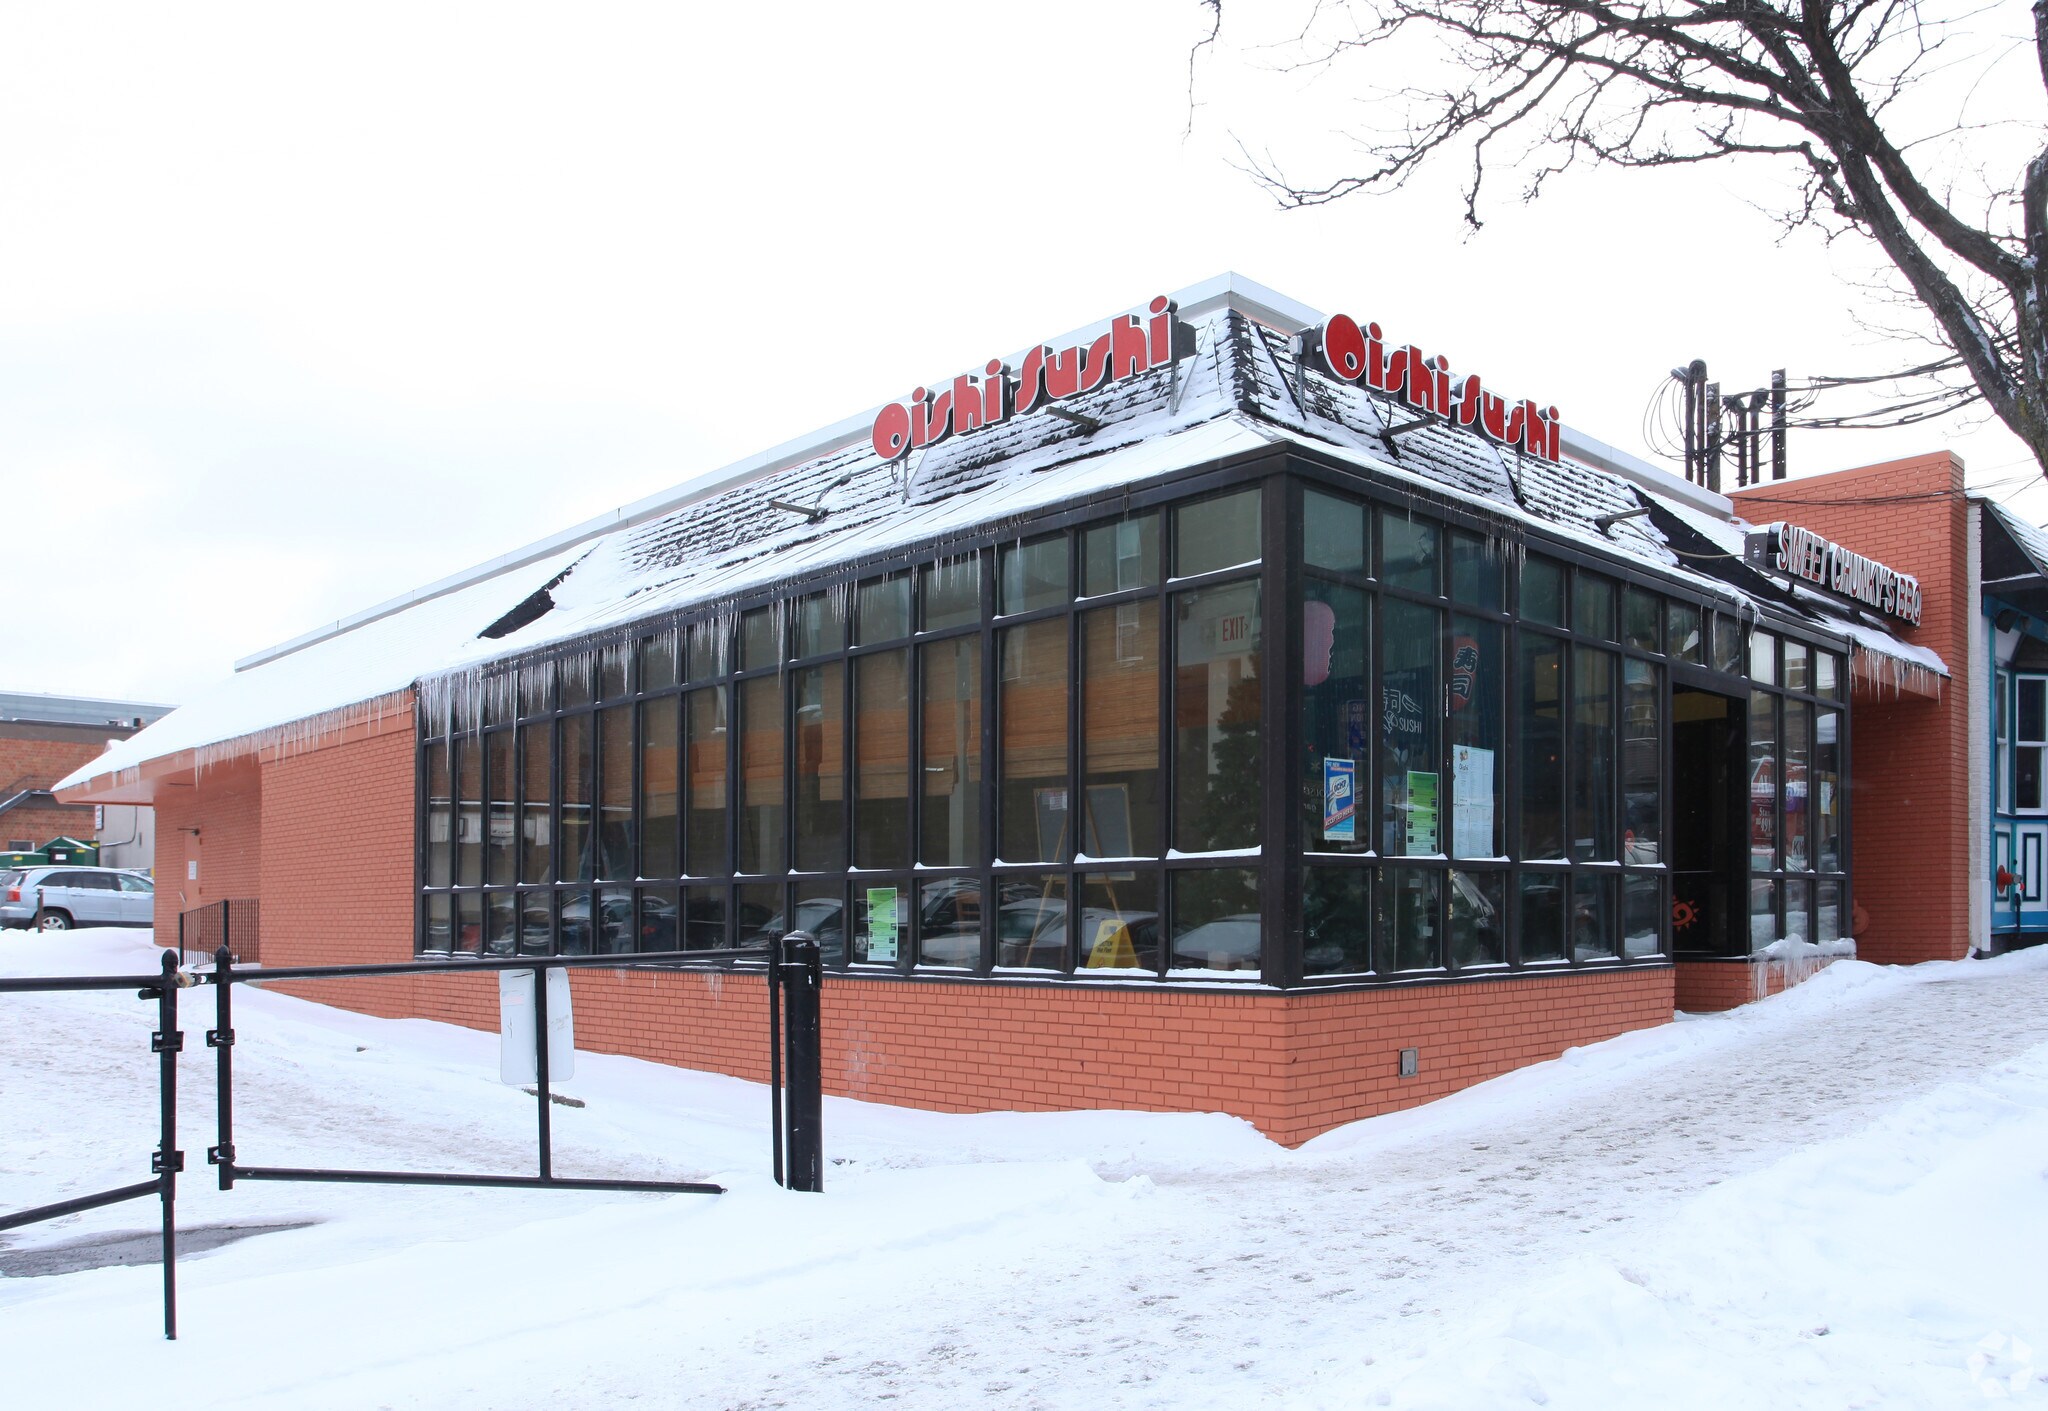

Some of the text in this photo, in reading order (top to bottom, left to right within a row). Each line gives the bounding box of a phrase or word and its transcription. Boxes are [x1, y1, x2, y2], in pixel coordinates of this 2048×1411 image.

[872, 295, 1174, 461] Oishi Sushi
[1321, 313, 1561, 463] Oishi Sushi
[1776, 522, 1922, 627] SWEET CHUNKY'S BBQ
[1222, 615, 1245, 642] EXIT
[1399, 717, 1422, 734] SUSHI
